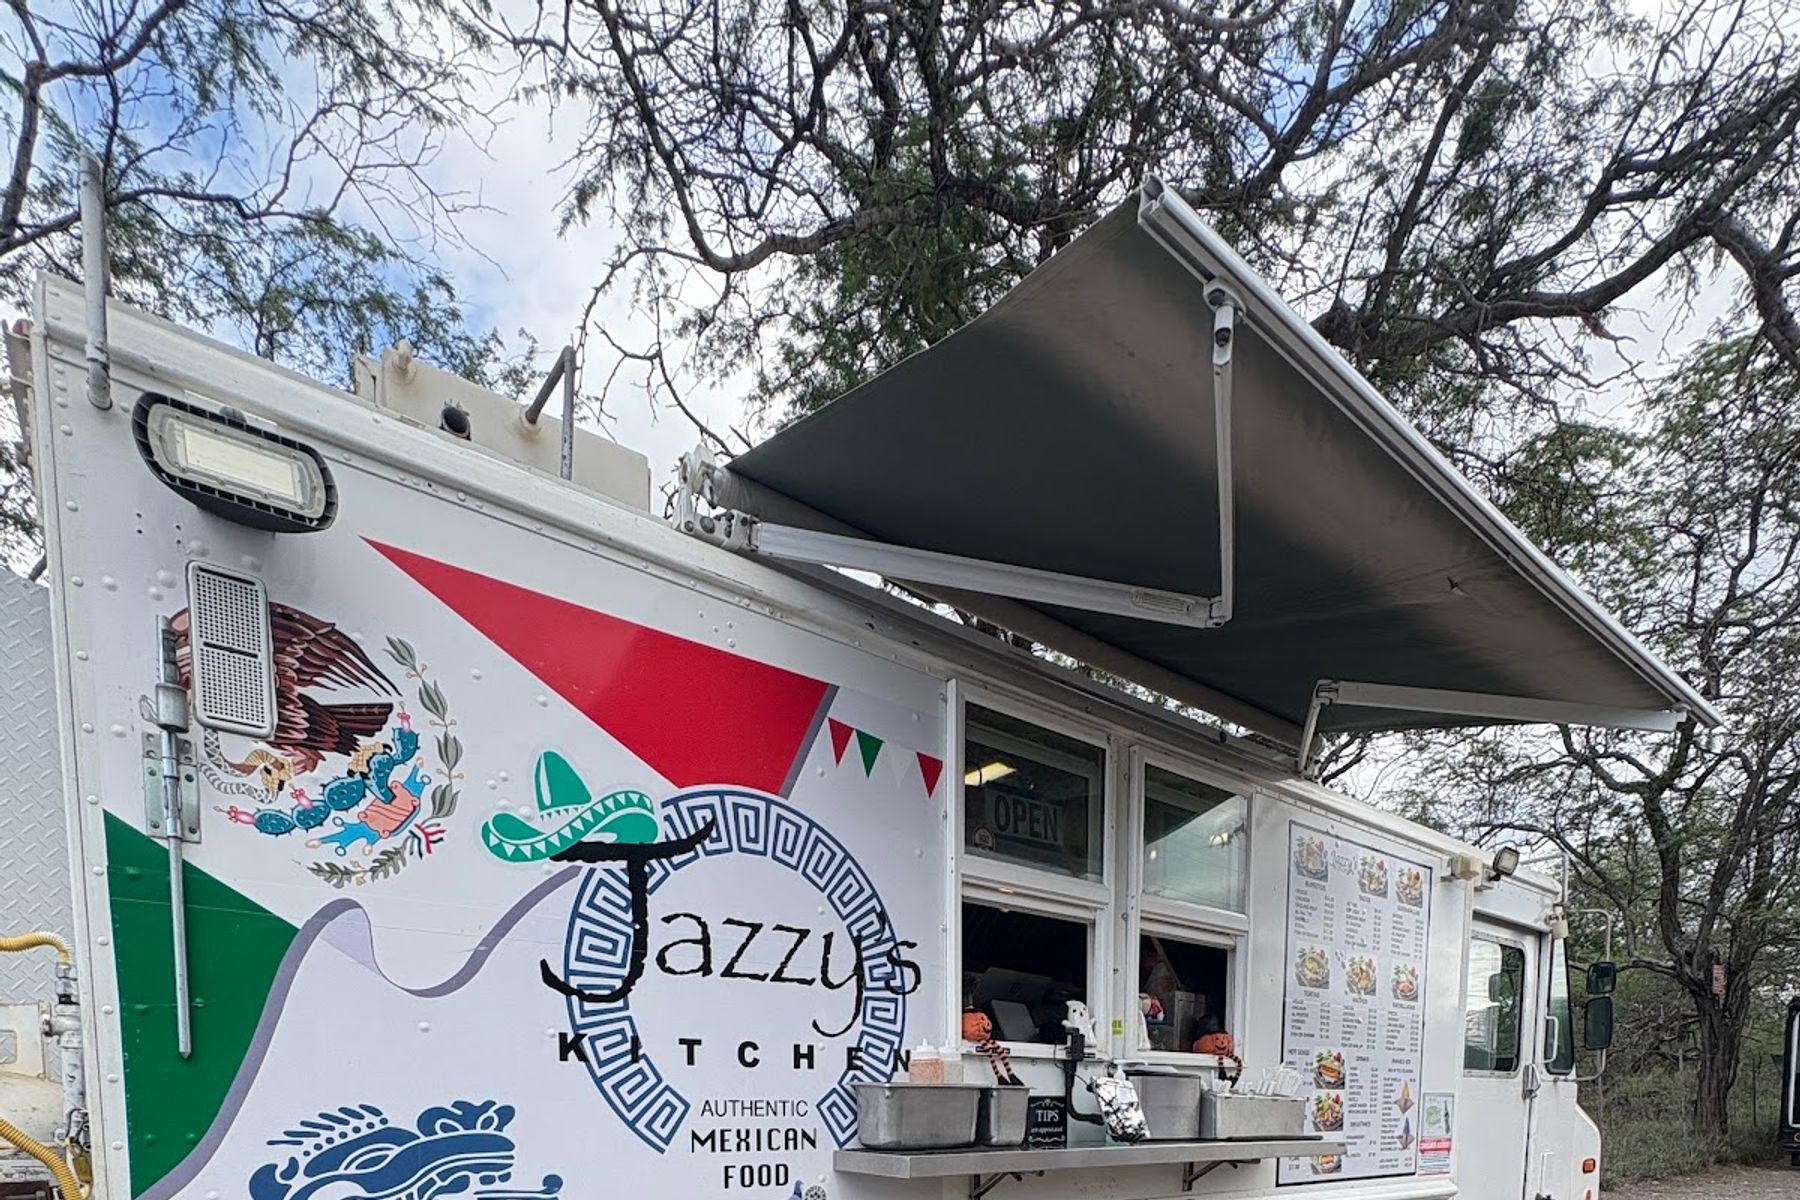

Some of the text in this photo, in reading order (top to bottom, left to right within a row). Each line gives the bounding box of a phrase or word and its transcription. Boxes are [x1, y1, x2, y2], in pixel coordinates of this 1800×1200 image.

[993, 795, 1060, 843] OPEN
[540, 814, 921, 1038] Jazzy's
[558, 1032, 911, 1074] KITCHEN
[700, 1099, 809, 1118] AUTHENTIC
[1035, 1109, 1059, 1122] TIPS
[691, 1128, 817, 1153] MEXICAN
[724, 1163, 789, 1189] FOOD
